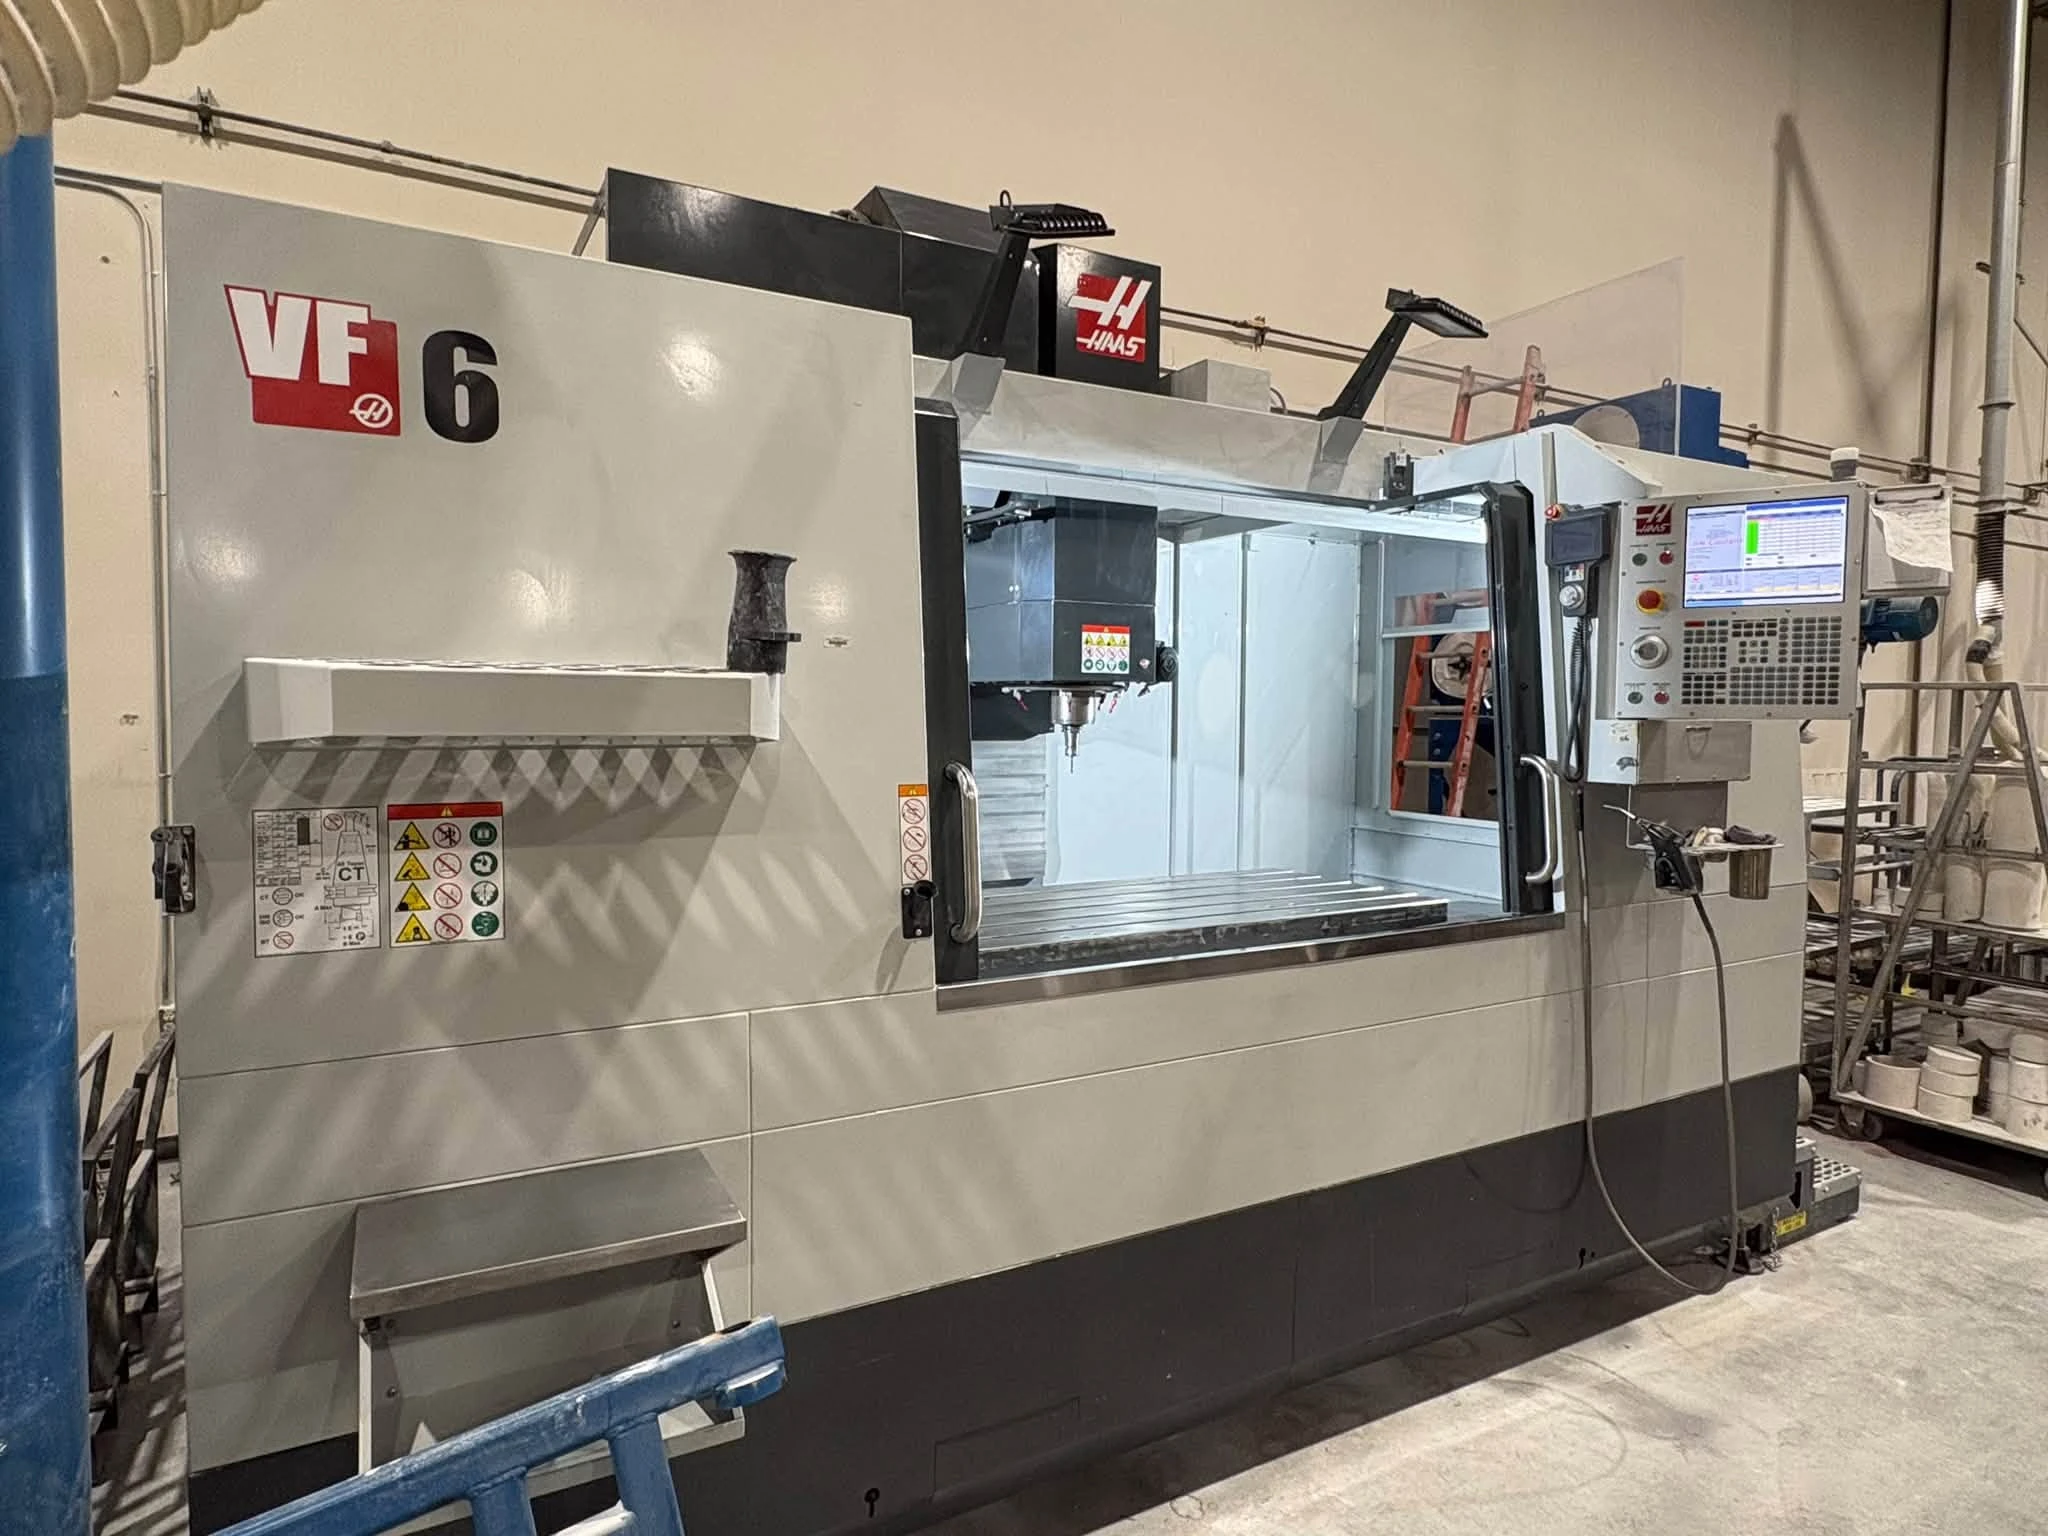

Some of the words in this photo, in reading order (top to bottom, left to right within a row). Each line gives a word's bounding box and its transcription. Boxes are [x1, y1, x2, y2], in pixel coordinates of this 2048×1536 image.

[227, 286, 368, 386] VF
[1076, 330, 1146, 356] HAAS
[422, 329, 500, 444] 6
[1636, 523, 1671, 534] HAAS
[338, 866, 365, 881] CT
